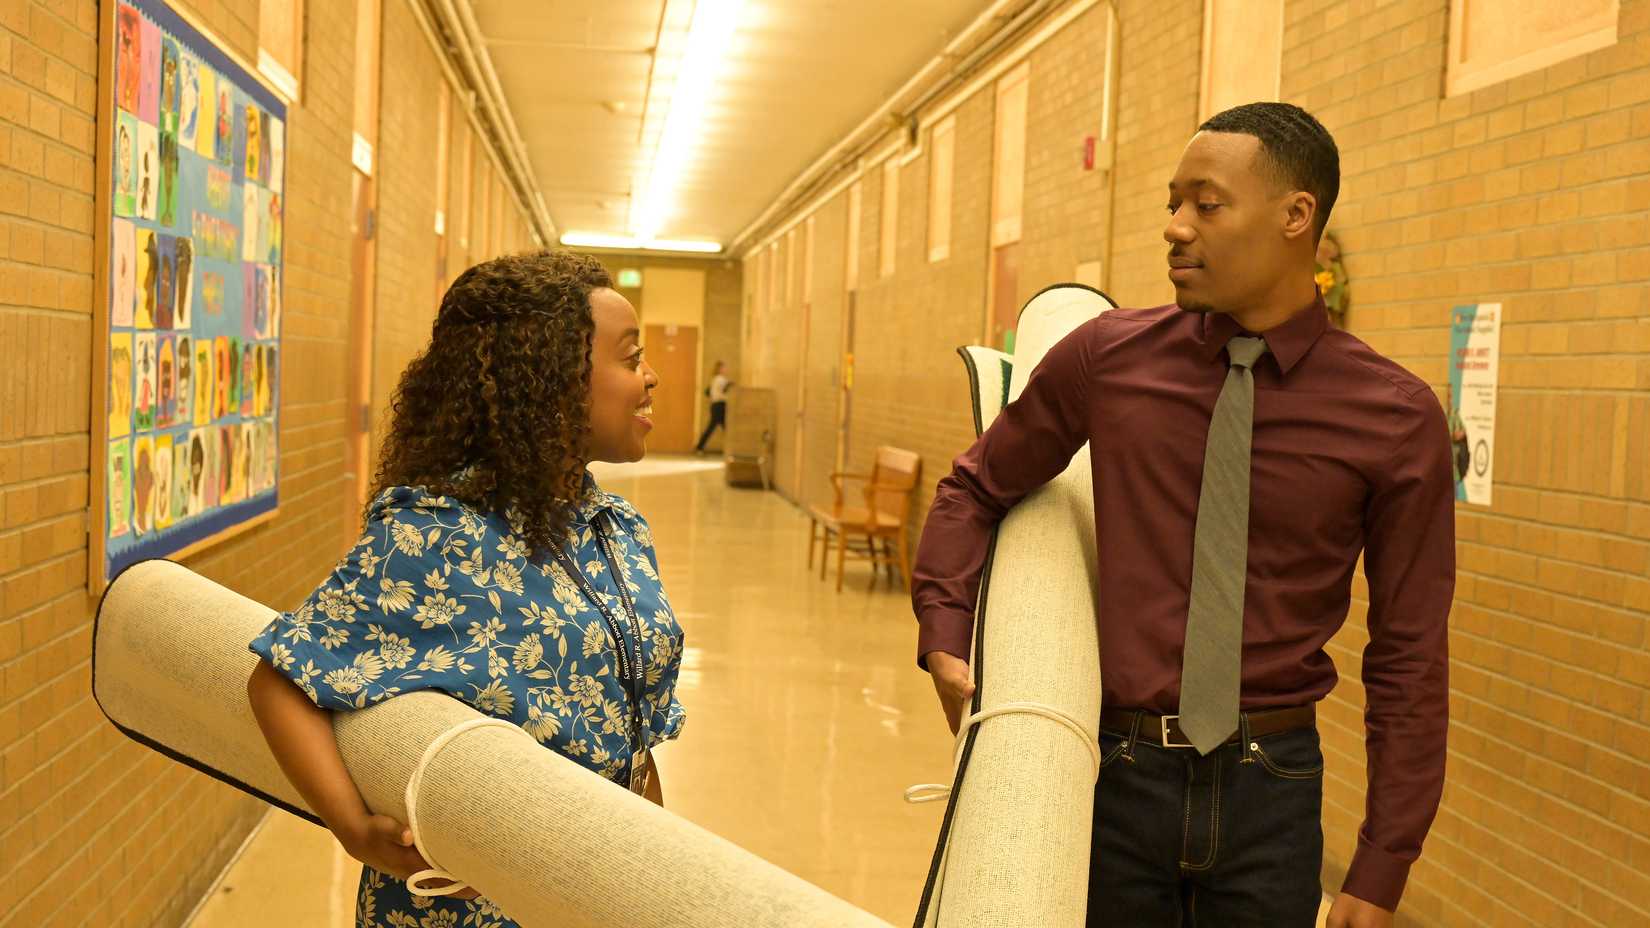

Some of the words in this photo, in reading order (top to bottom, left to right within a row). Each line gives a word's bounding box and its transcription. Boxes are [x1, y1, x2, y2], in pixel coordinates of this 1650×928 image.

[583, 582, 602, 607] Willard
[607, 615, 621, 639] Abbott
[619, 639, 630, 681] Elementary
[636, 653, 644, 681] Willard
